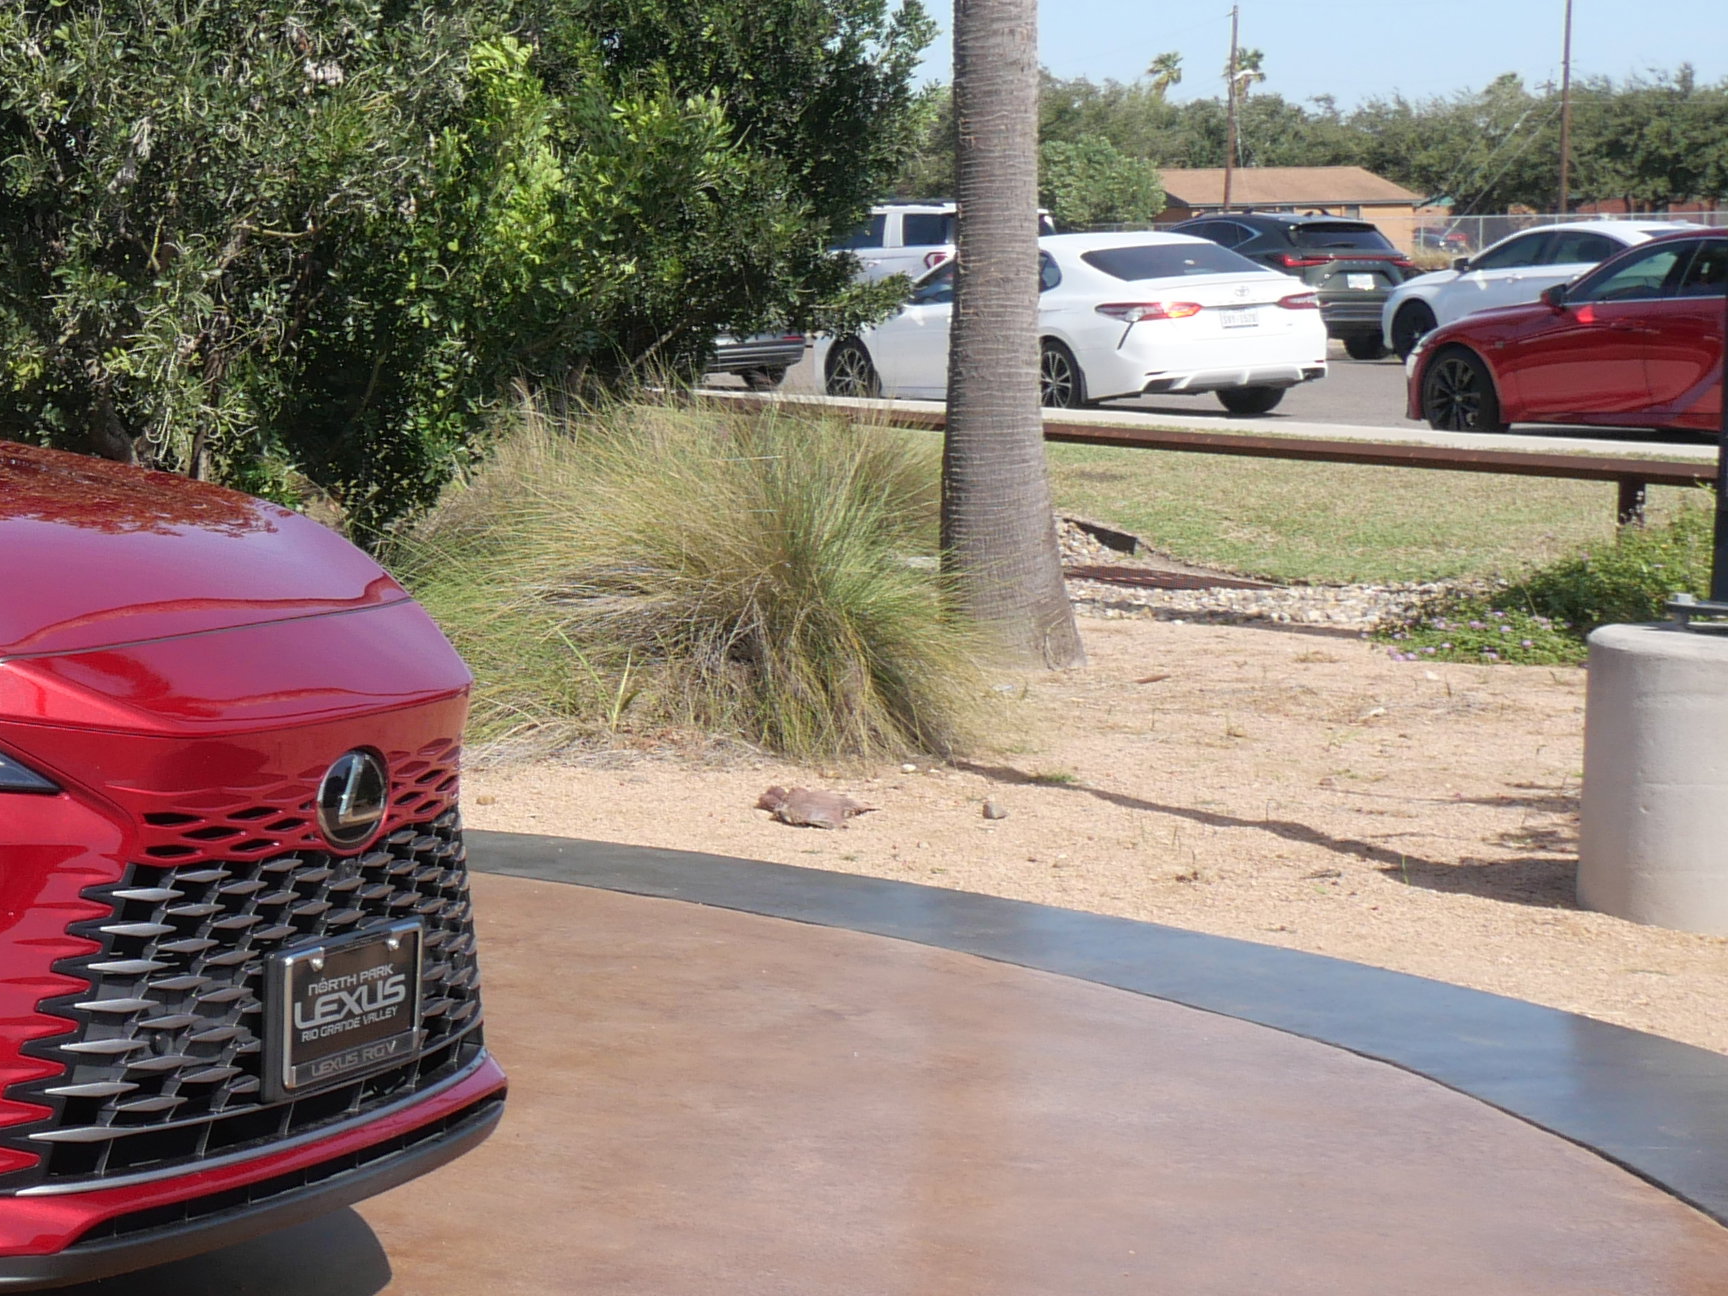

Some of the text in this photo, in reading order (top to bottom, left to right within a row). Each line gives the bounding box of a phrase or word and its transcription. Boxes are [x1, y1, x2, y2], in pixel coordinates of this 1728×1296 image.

[359, 963, 394, 983] PARK
[294, 974, 406, 1030] LEXUS
[301, 1005, 398, 1042] RIO GRANDE VALLEY
[311, 1040, 397, 1077] LEXUS RGV
